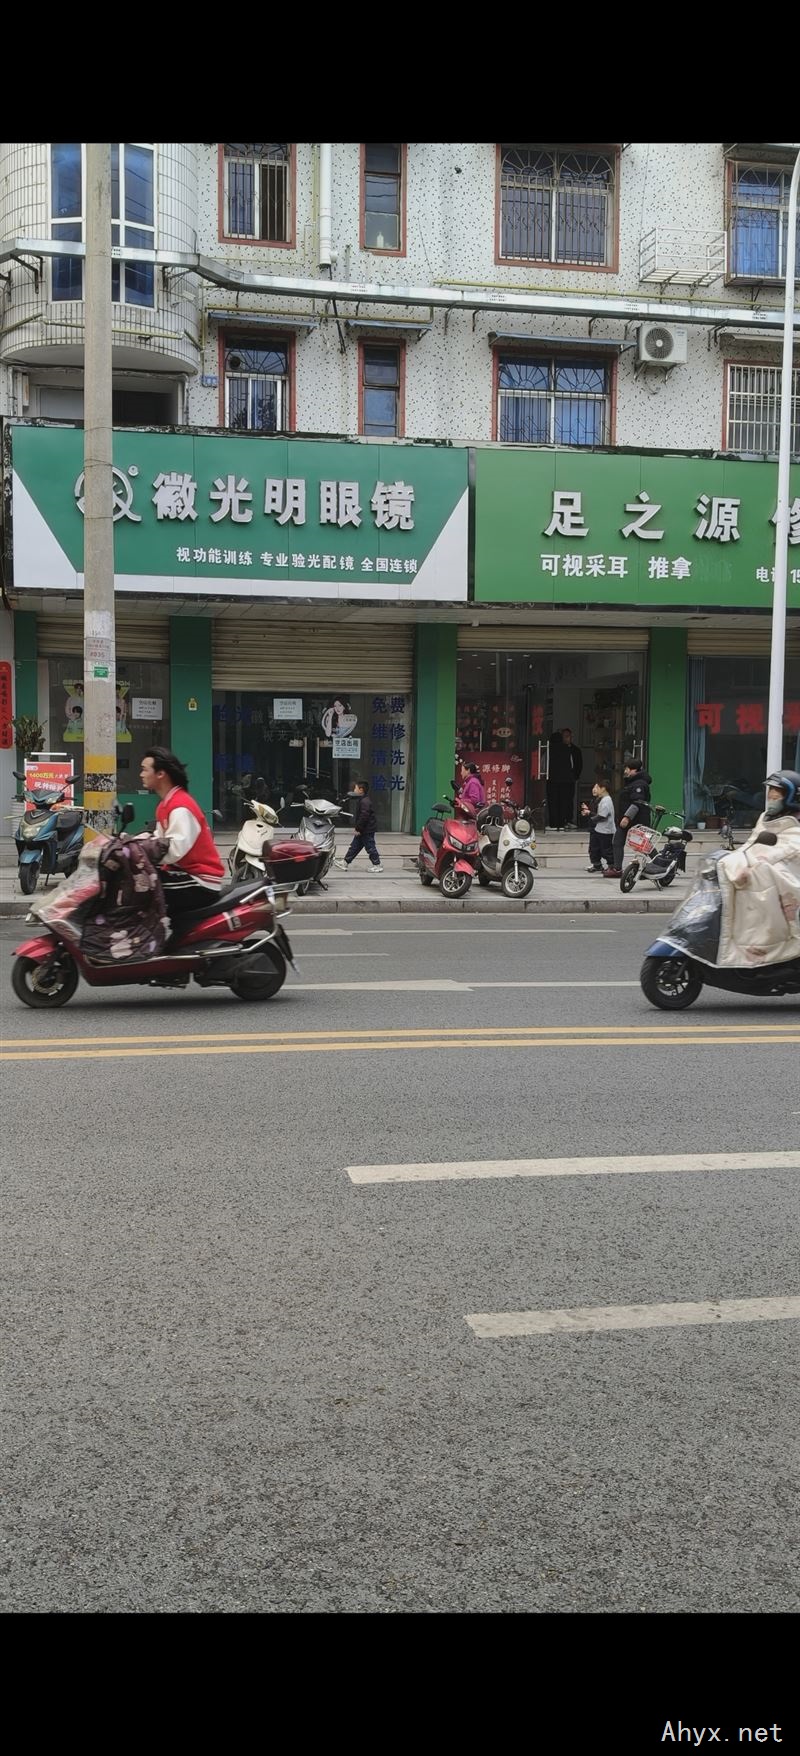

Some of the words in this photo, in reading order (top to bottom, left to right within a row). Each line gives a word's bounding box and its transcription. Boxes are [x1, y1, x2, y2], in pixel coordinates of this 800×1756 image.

[152, 472, 415, 531] 徽光明眼镜
[176, 546, 253, 566] 视功能训练
[260, 551, 355, 571] 专业验光配镜
[360, 557, 418, 574] 全国连锁
[540, 553, 628, 578] 可视采耳
[648, 556, 692, 580] 推拿
[372, 697, 405, 714] 免费
[371, 723, 406, 740] 维修
[372, 749, 405, 766] 清洗
[372, 774, 405, 792] 验光
